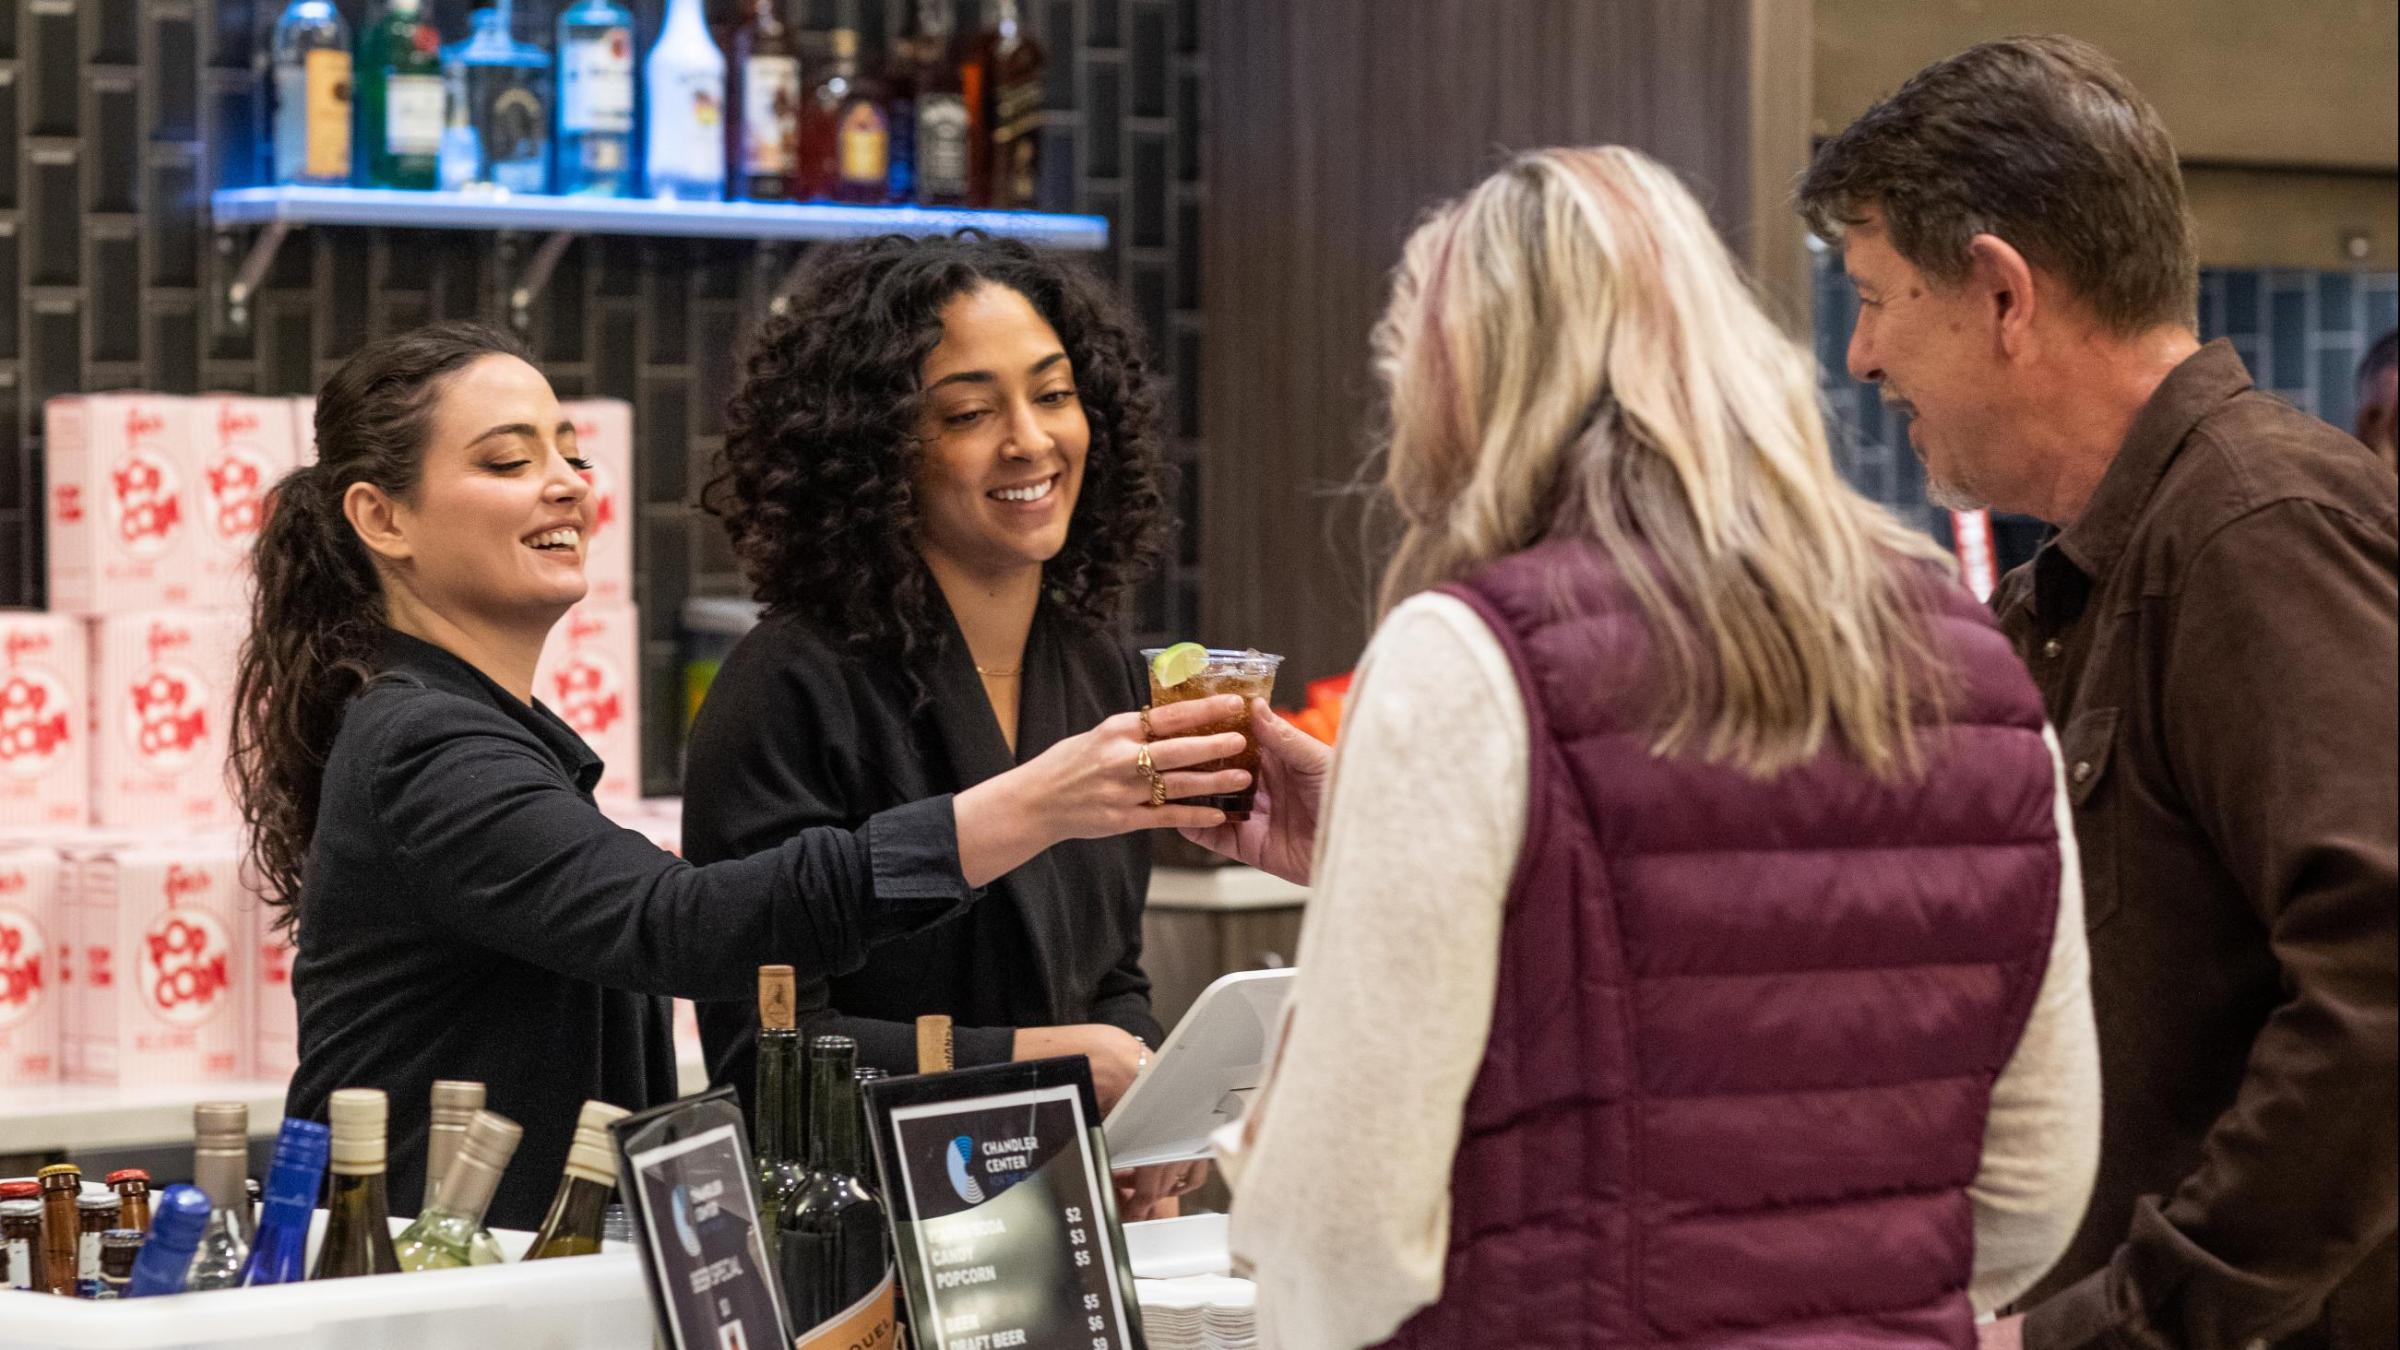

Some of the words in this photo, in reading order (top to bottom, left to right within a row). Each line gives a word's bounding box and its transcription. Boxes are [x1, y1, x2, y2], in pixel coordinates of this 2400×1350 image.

[147, 920, 206, 968] POP
[156, 955, 230, 1009] CORN
[982, 1136, 1039, 1156] CHANDLER
[985, 1155, 1027, 1173] CENTER
[1065, 1206, 1082, 1223] $2
[1069, 1228, 1087, 1245] $3
[936, 1265, 997, 1290] POPCORN
[1074, 1250, 1091, 1267] $5
[1083, 1293, 1100, 1310] $5
[991, 1328, 1027, 1349] BEER
